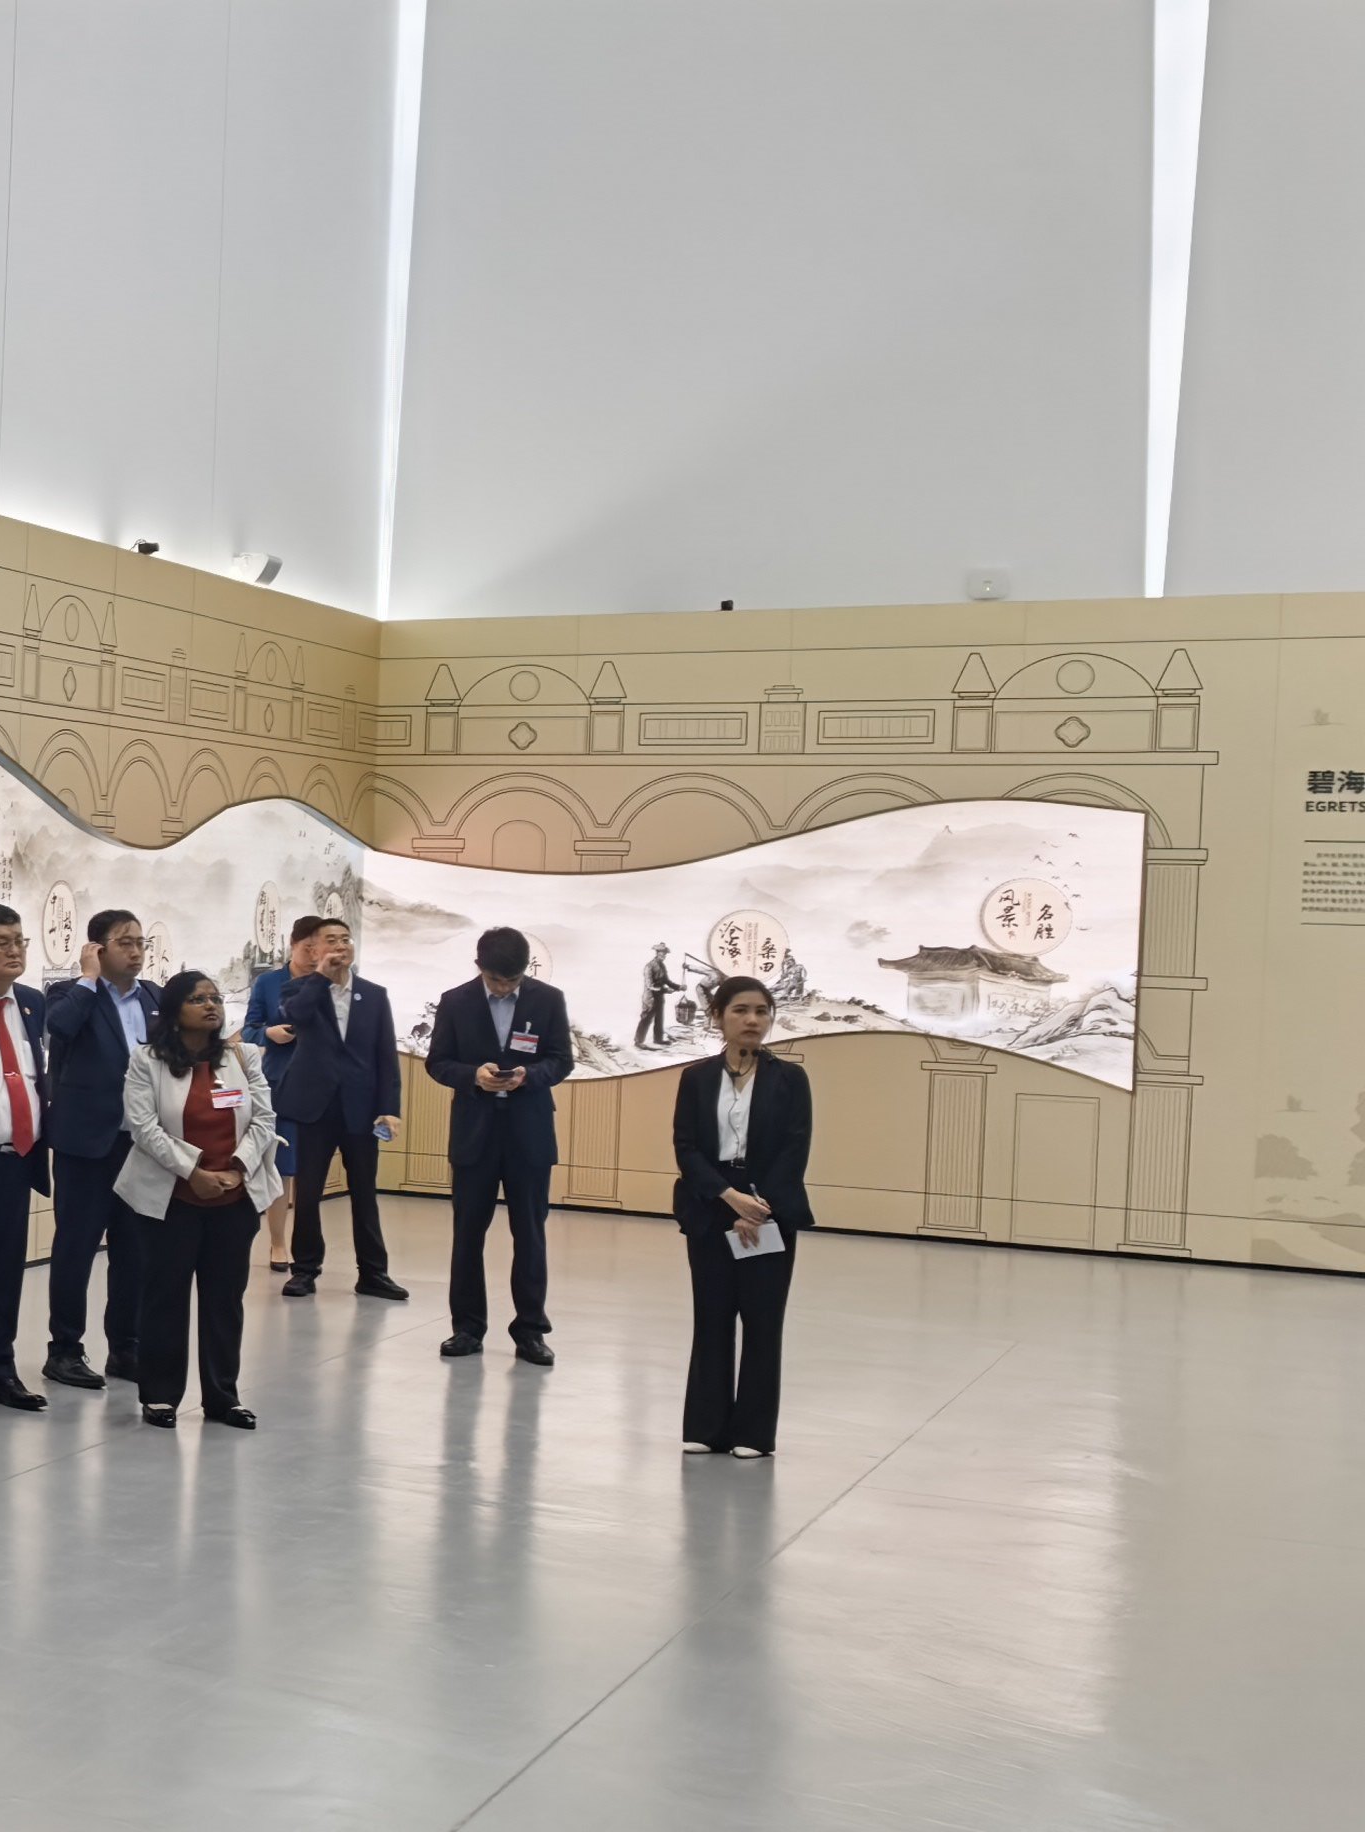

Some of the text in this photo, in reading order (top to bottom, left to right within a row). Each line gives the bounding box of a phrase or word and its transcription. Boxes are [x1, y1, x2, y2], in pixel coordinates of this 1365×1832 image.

[1307, 770, 1365, 795] 碧海
[996, 889, 1020, 928] 风景
[1034, 904, 1056, 941] 名胜
[758, 937, 778, 973] 桑田
